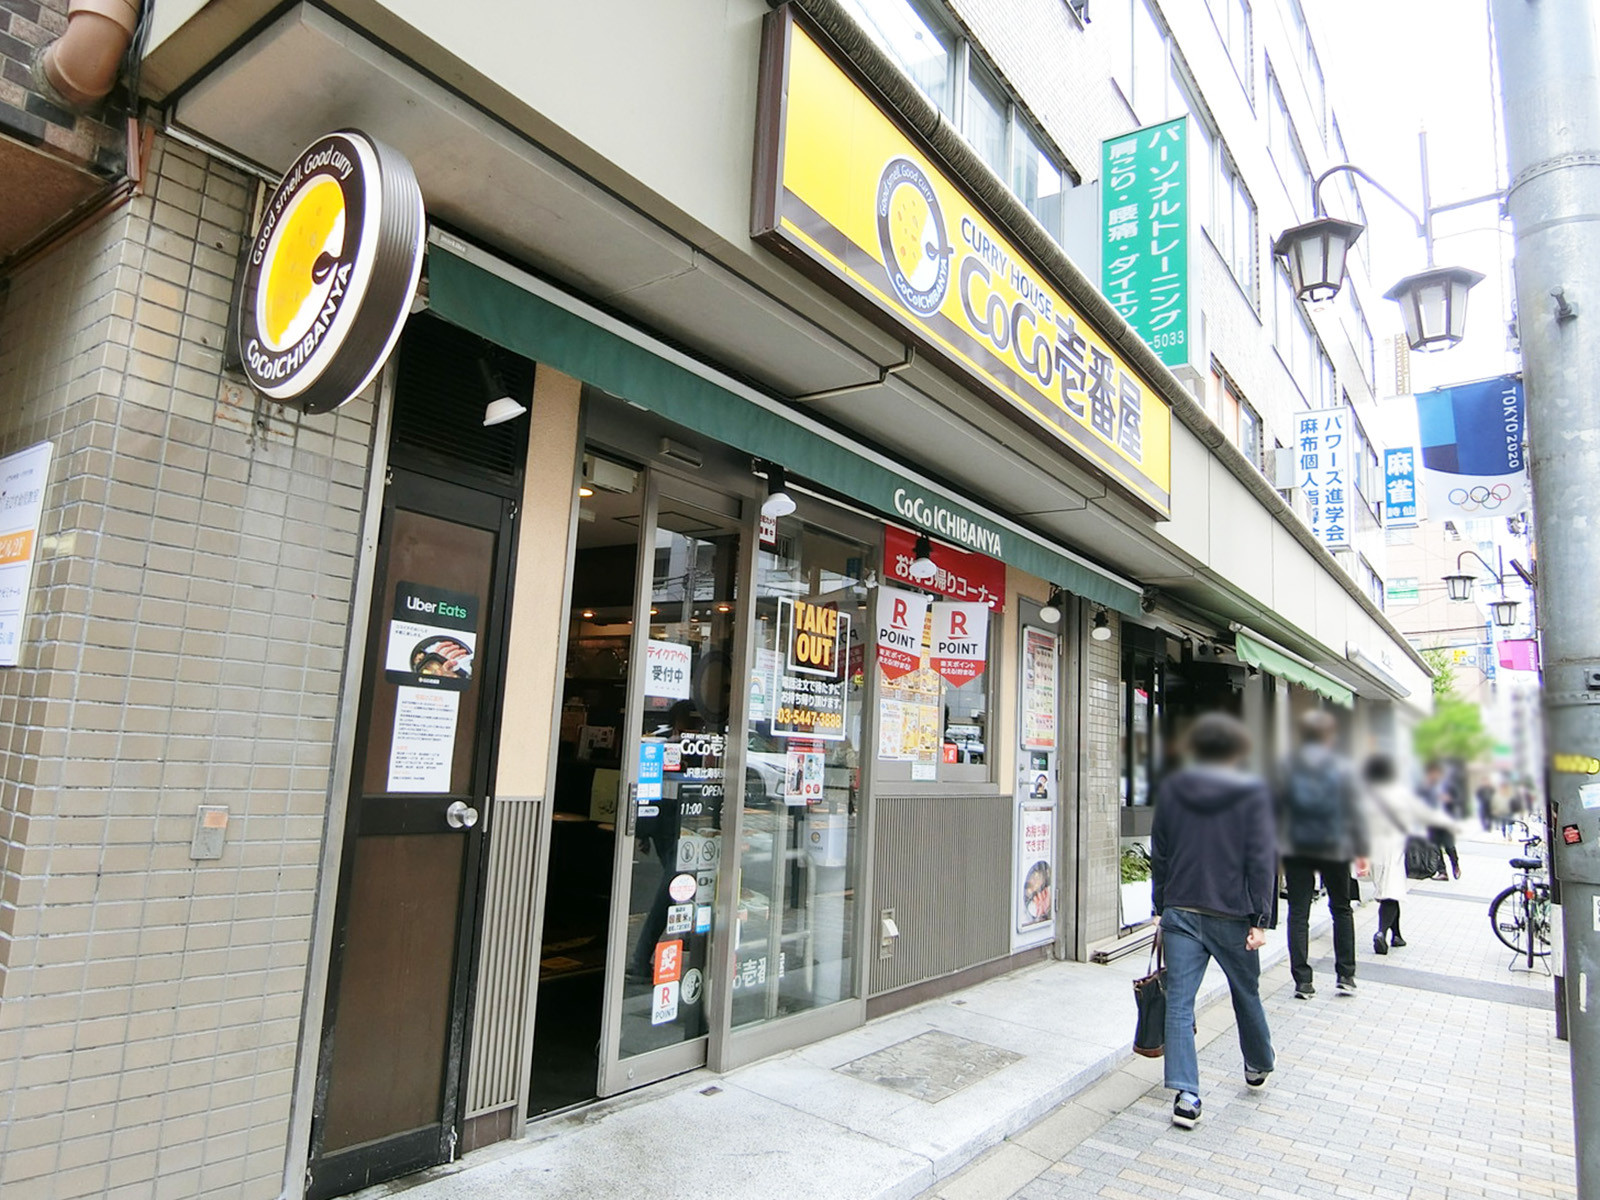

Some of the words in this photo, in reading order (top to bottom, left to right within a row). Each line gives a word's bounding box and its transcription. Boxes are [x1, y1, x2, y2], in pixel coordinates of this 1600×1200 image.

[918, 177, 934, 203] curry
[253, 217, 275, 265] Good
[275, 166, 303, 212] smell.
[303, 144, 333, 176] Good
[331, 150, 354, 181] curry
[1108, 138, 1139, 330] 肩こり・腰痛・ダイエッ
[961, 217, 1008, 278] CURRY
[1009, 264, 1053, 322] HOUSE
[1502, 386, 1519, 433] TOKYO
[1506, 434, 1520, 468] 2020
[1324, 414, 1344, 542] パワーズ進学会
[1386, 452, 1414, 504] 麻雀
[407, 596, 437, 613] Uber
[438, 602, 467, 619] Eats
[794, 600, 837, 637] TAKE
[892, 598, 908, 627] R
[951, 611, 968, 635] R
[796, 633, 833, 666] OUT
[879, 628, 915, 649] POINT
[939, 642, 978, 655] POINT
[647, 646, 689, 663] テイクアウト
[652, 665, 683, 683] 受付中
[680, 802, 702, 815] 11:00
[662, 987, 670, 1004] R
[655, 1008, 675, 1020] POINT
